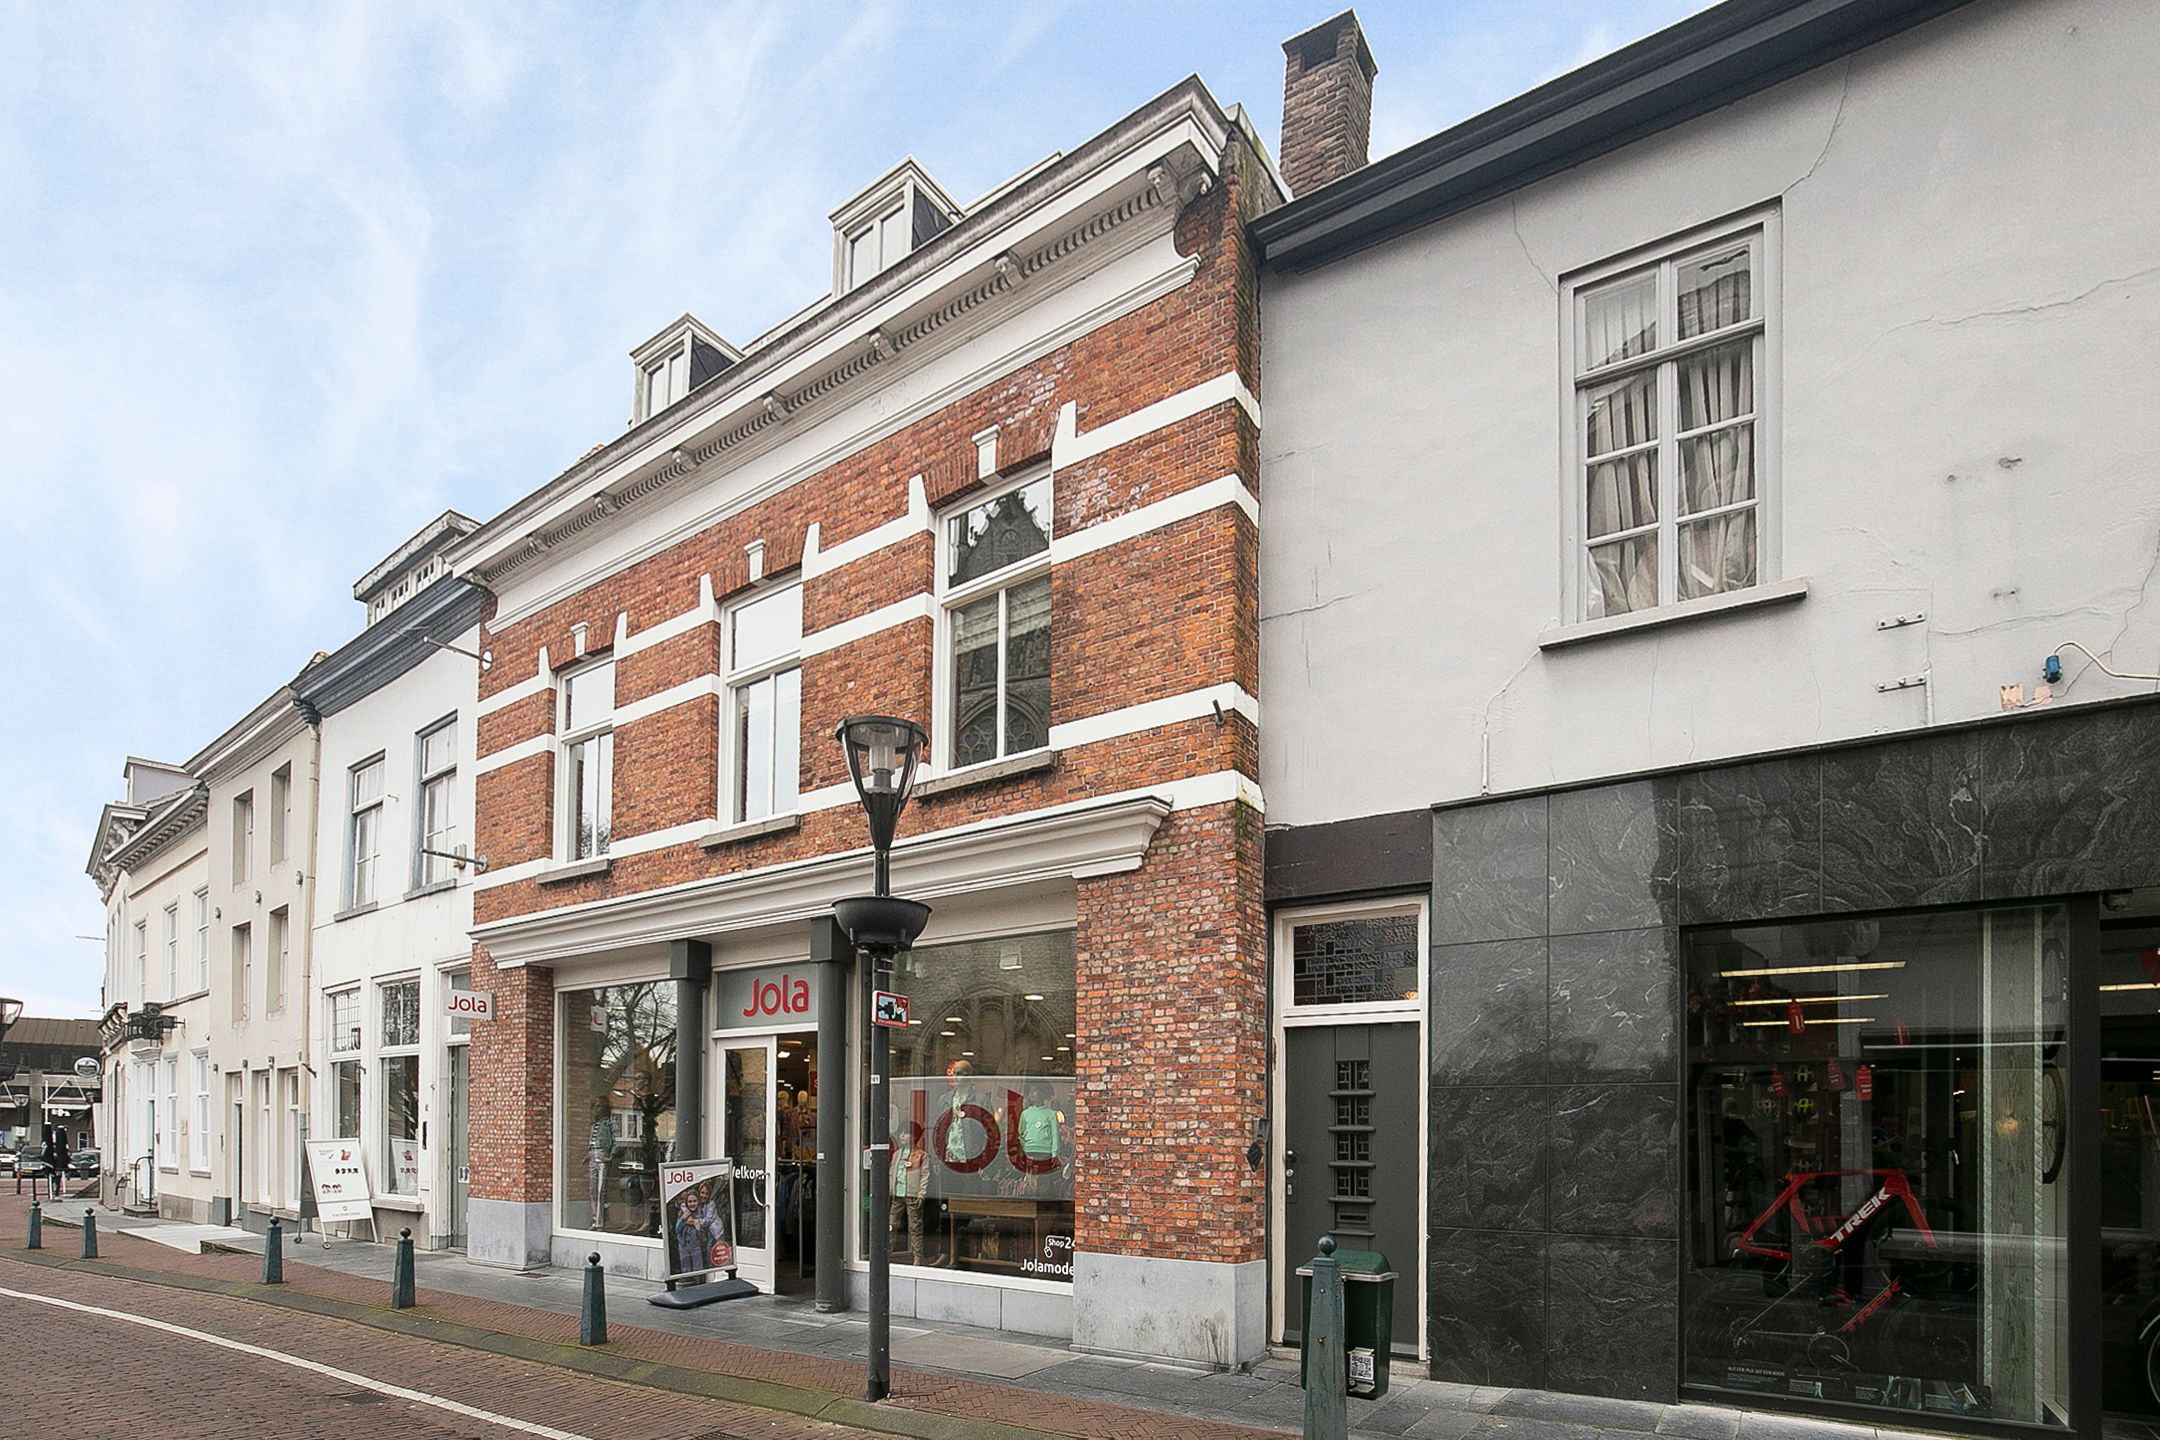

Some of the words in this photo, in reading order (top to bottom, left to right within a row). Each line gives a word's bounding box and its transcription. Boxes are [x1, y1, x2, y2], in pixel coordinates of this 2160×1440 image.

[448, 995, 487, 1013] Jola
[742, 974, 810, 1017] Jola
[667, 1170, 694, 1185] Jola
[1830, 1186, 1891, 1242] TREK
[1048, 1238, 1065, 1248] Shop
[1020, 1258, 1075, 1276] Jolamode
